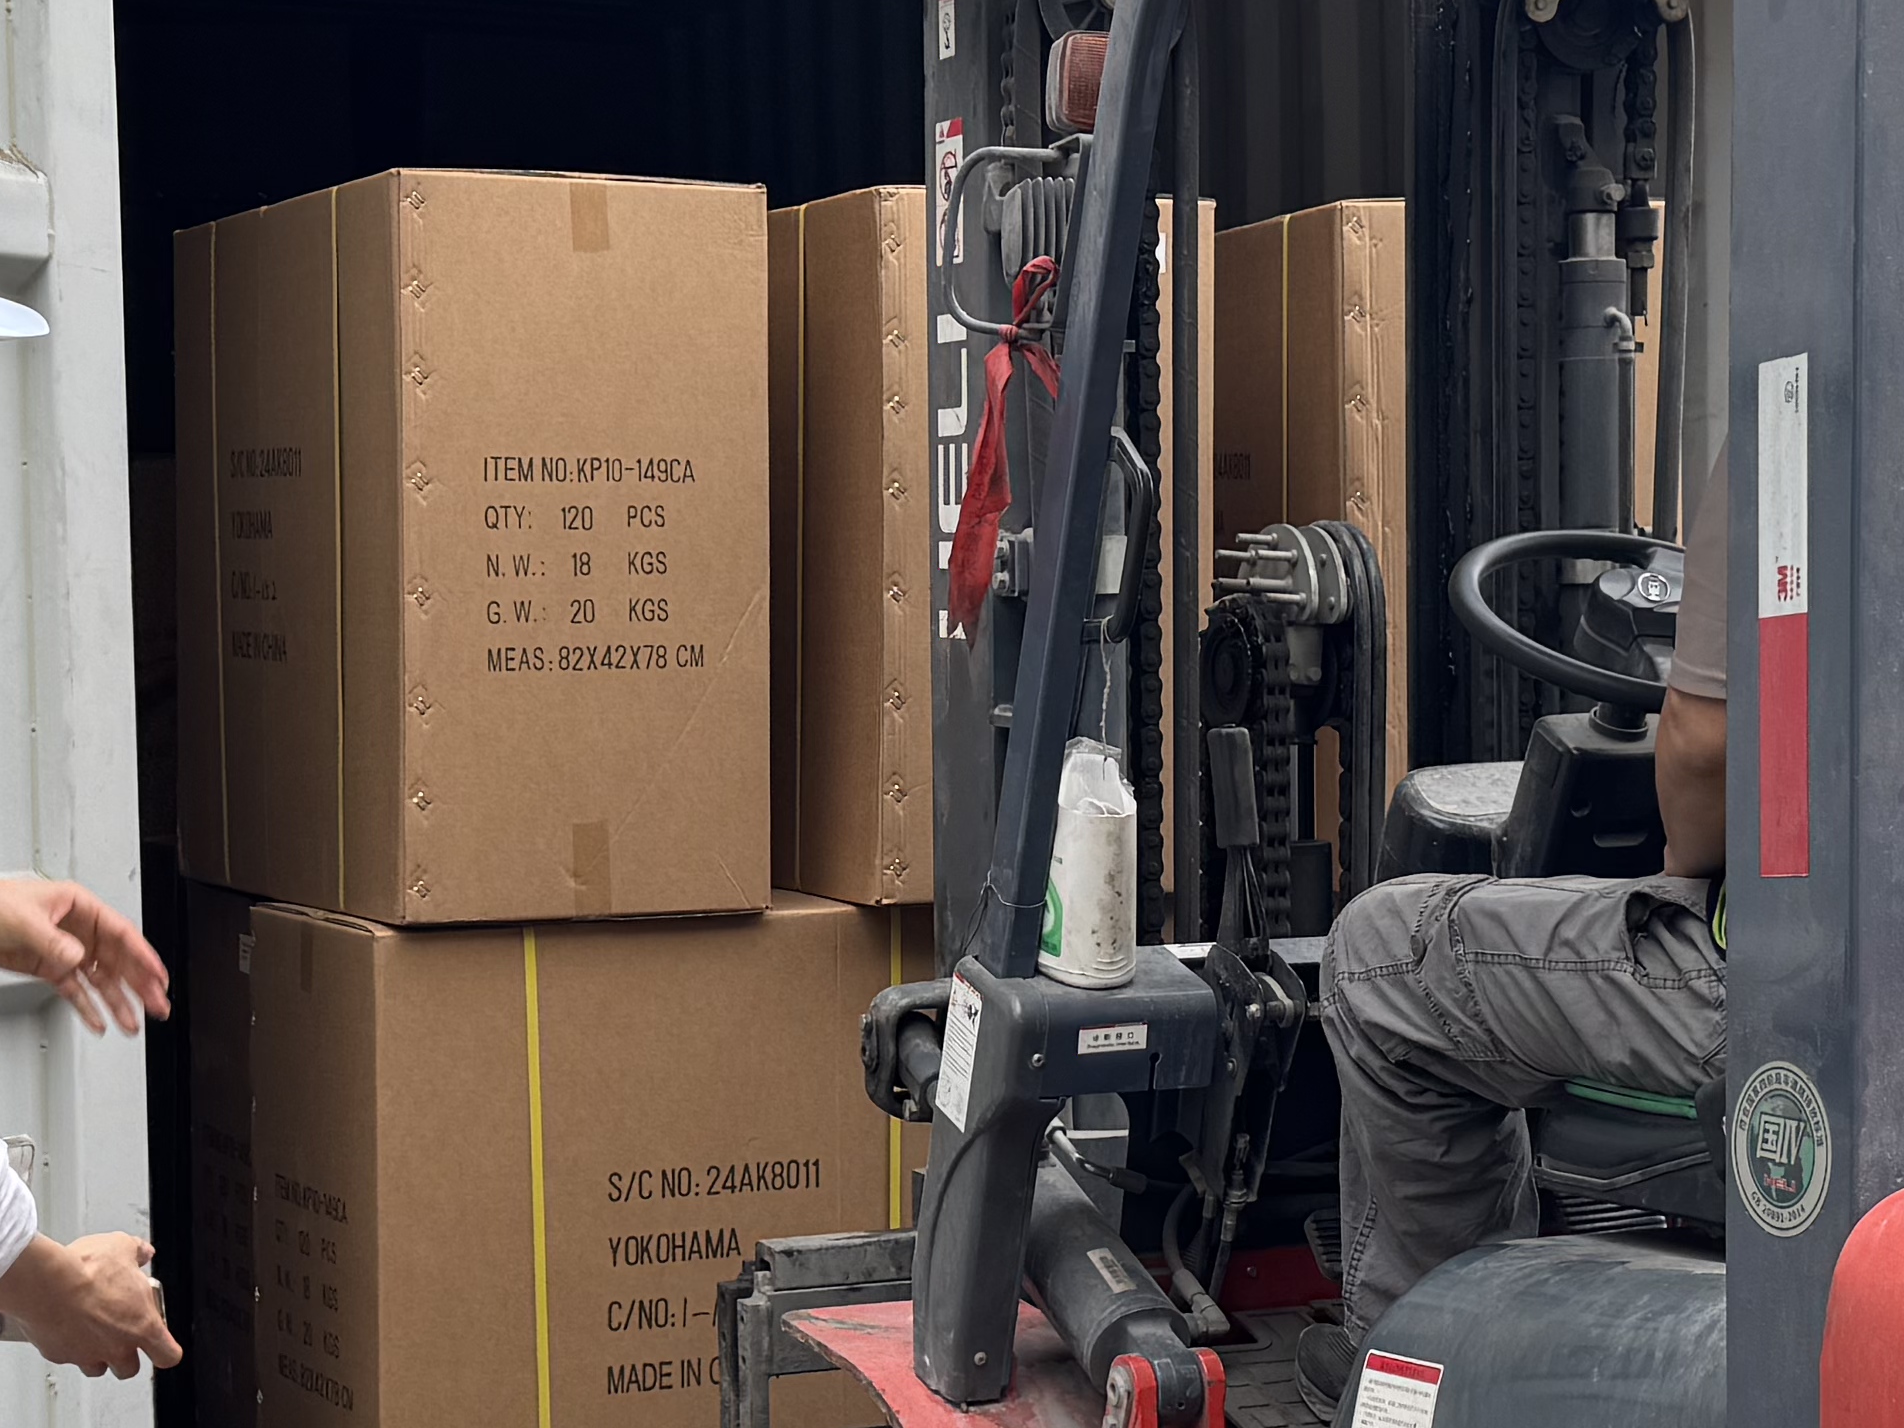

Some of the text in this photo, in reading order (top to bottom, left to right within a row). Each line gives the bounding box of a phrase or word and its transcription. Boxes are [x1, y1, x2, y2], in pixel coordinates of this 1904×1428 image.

[483, 457, 534, 483] ITEM
[484, 505, 666, 531] QTY: 120 PCS
[571, 551, 591, 577] 18
[627, 551, 668, 575] KGS
[570, 598, 596, 624] 20
[629, 598, 669, 623] KGS
[676, 644, 704, 668] CM
[607, 1157, 821, 1203] S/C NO: 24AK8011
[608, 1227, 742, 1268] YOKOHAMA
[607, 1360, 674, 1396] MADE
[680, 1356, 702, 1389] IN
